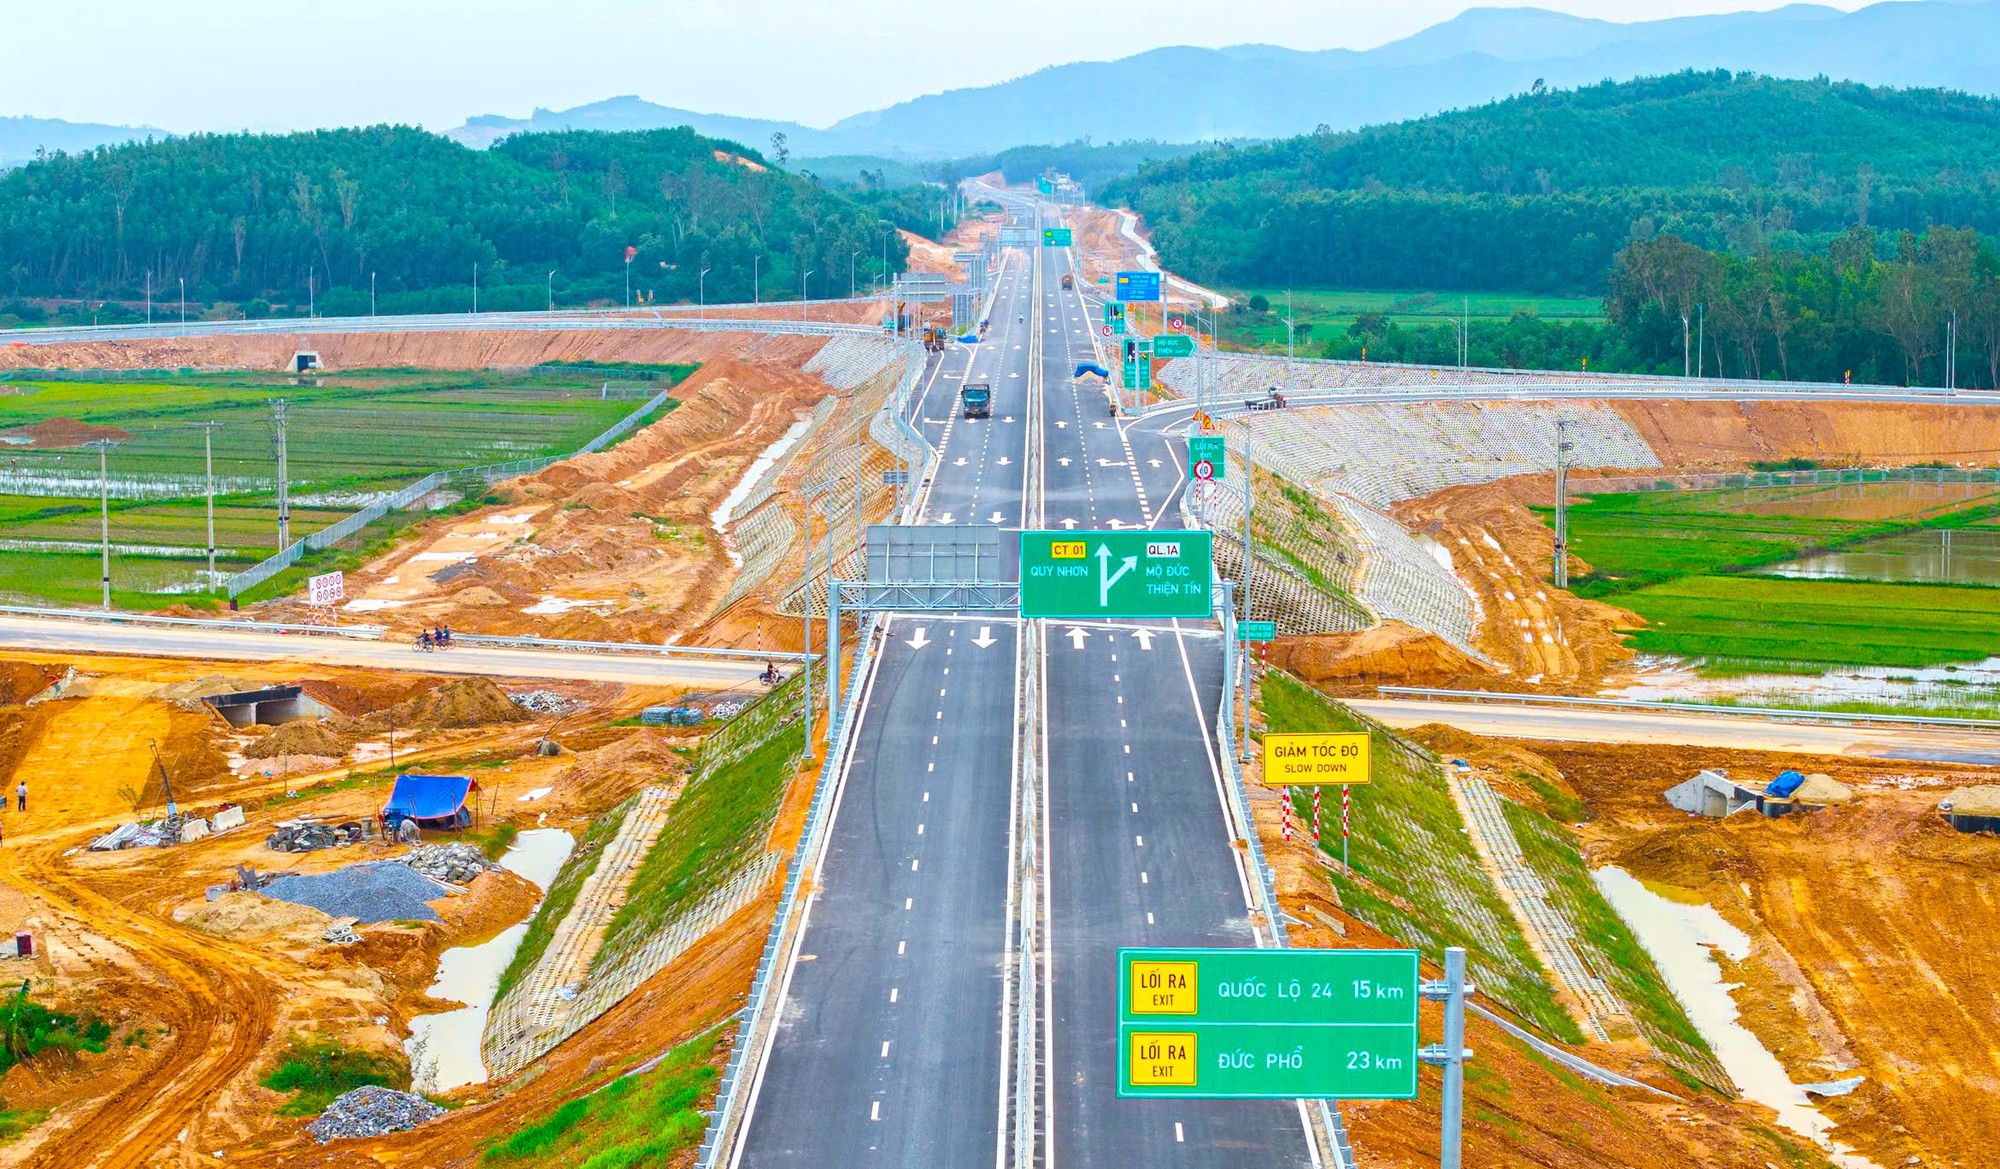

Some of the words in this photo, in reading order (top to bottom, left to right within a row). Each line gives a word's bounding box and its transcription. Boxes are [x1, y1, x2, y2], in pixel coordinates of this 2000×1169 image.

[1148, 545, 1178, 557] QL.1A
[1031, 566, 1053, 577] QUY
[1057, 565, 1088, 577] NHƠN
[1146, 564, 1162, 579] MỘ
[1166, 563, 1190, 577] ĐỨC
[1146, 580, 1179, 597] THIỆN
[1183, 581, 1201, 595] TÍN
[1275, 742, 1307, 758] GIẢM
[1312, 740, 1336, 757] TỐC
[1341, 742, 1359, 759] ĐỘ
[1284, 764, 1313, 773] SLOW
[1317, 764, 1347, 773] DOWN
[1141, 968, 1162, 989] LỐI
[1168, 974, 1187, 989] RA
[1218, 976, 1267, 998] QUỐC
[1278, 979, 1301, 1002] LỘ
[1311, 982, 1333, 998] 24
[1352, 980, 1371, 999] 15
[1376, 983, 1404, 999] km
[1153, 994, 1175, 1006] EXIT
[1140, 1039, 1161, 1060] LỐI
[1168, 1045, 1187, 1060] RA
[1218, 1049, 1256, 1069] ĐỨC
[1266, 1045, 1304, 1070] PHỔ
[1346, 1051, 1370, 1069] 23
[1375, 1054, 1402, 1070] km
[1152, 1065, 1174, 1078] EXIT
